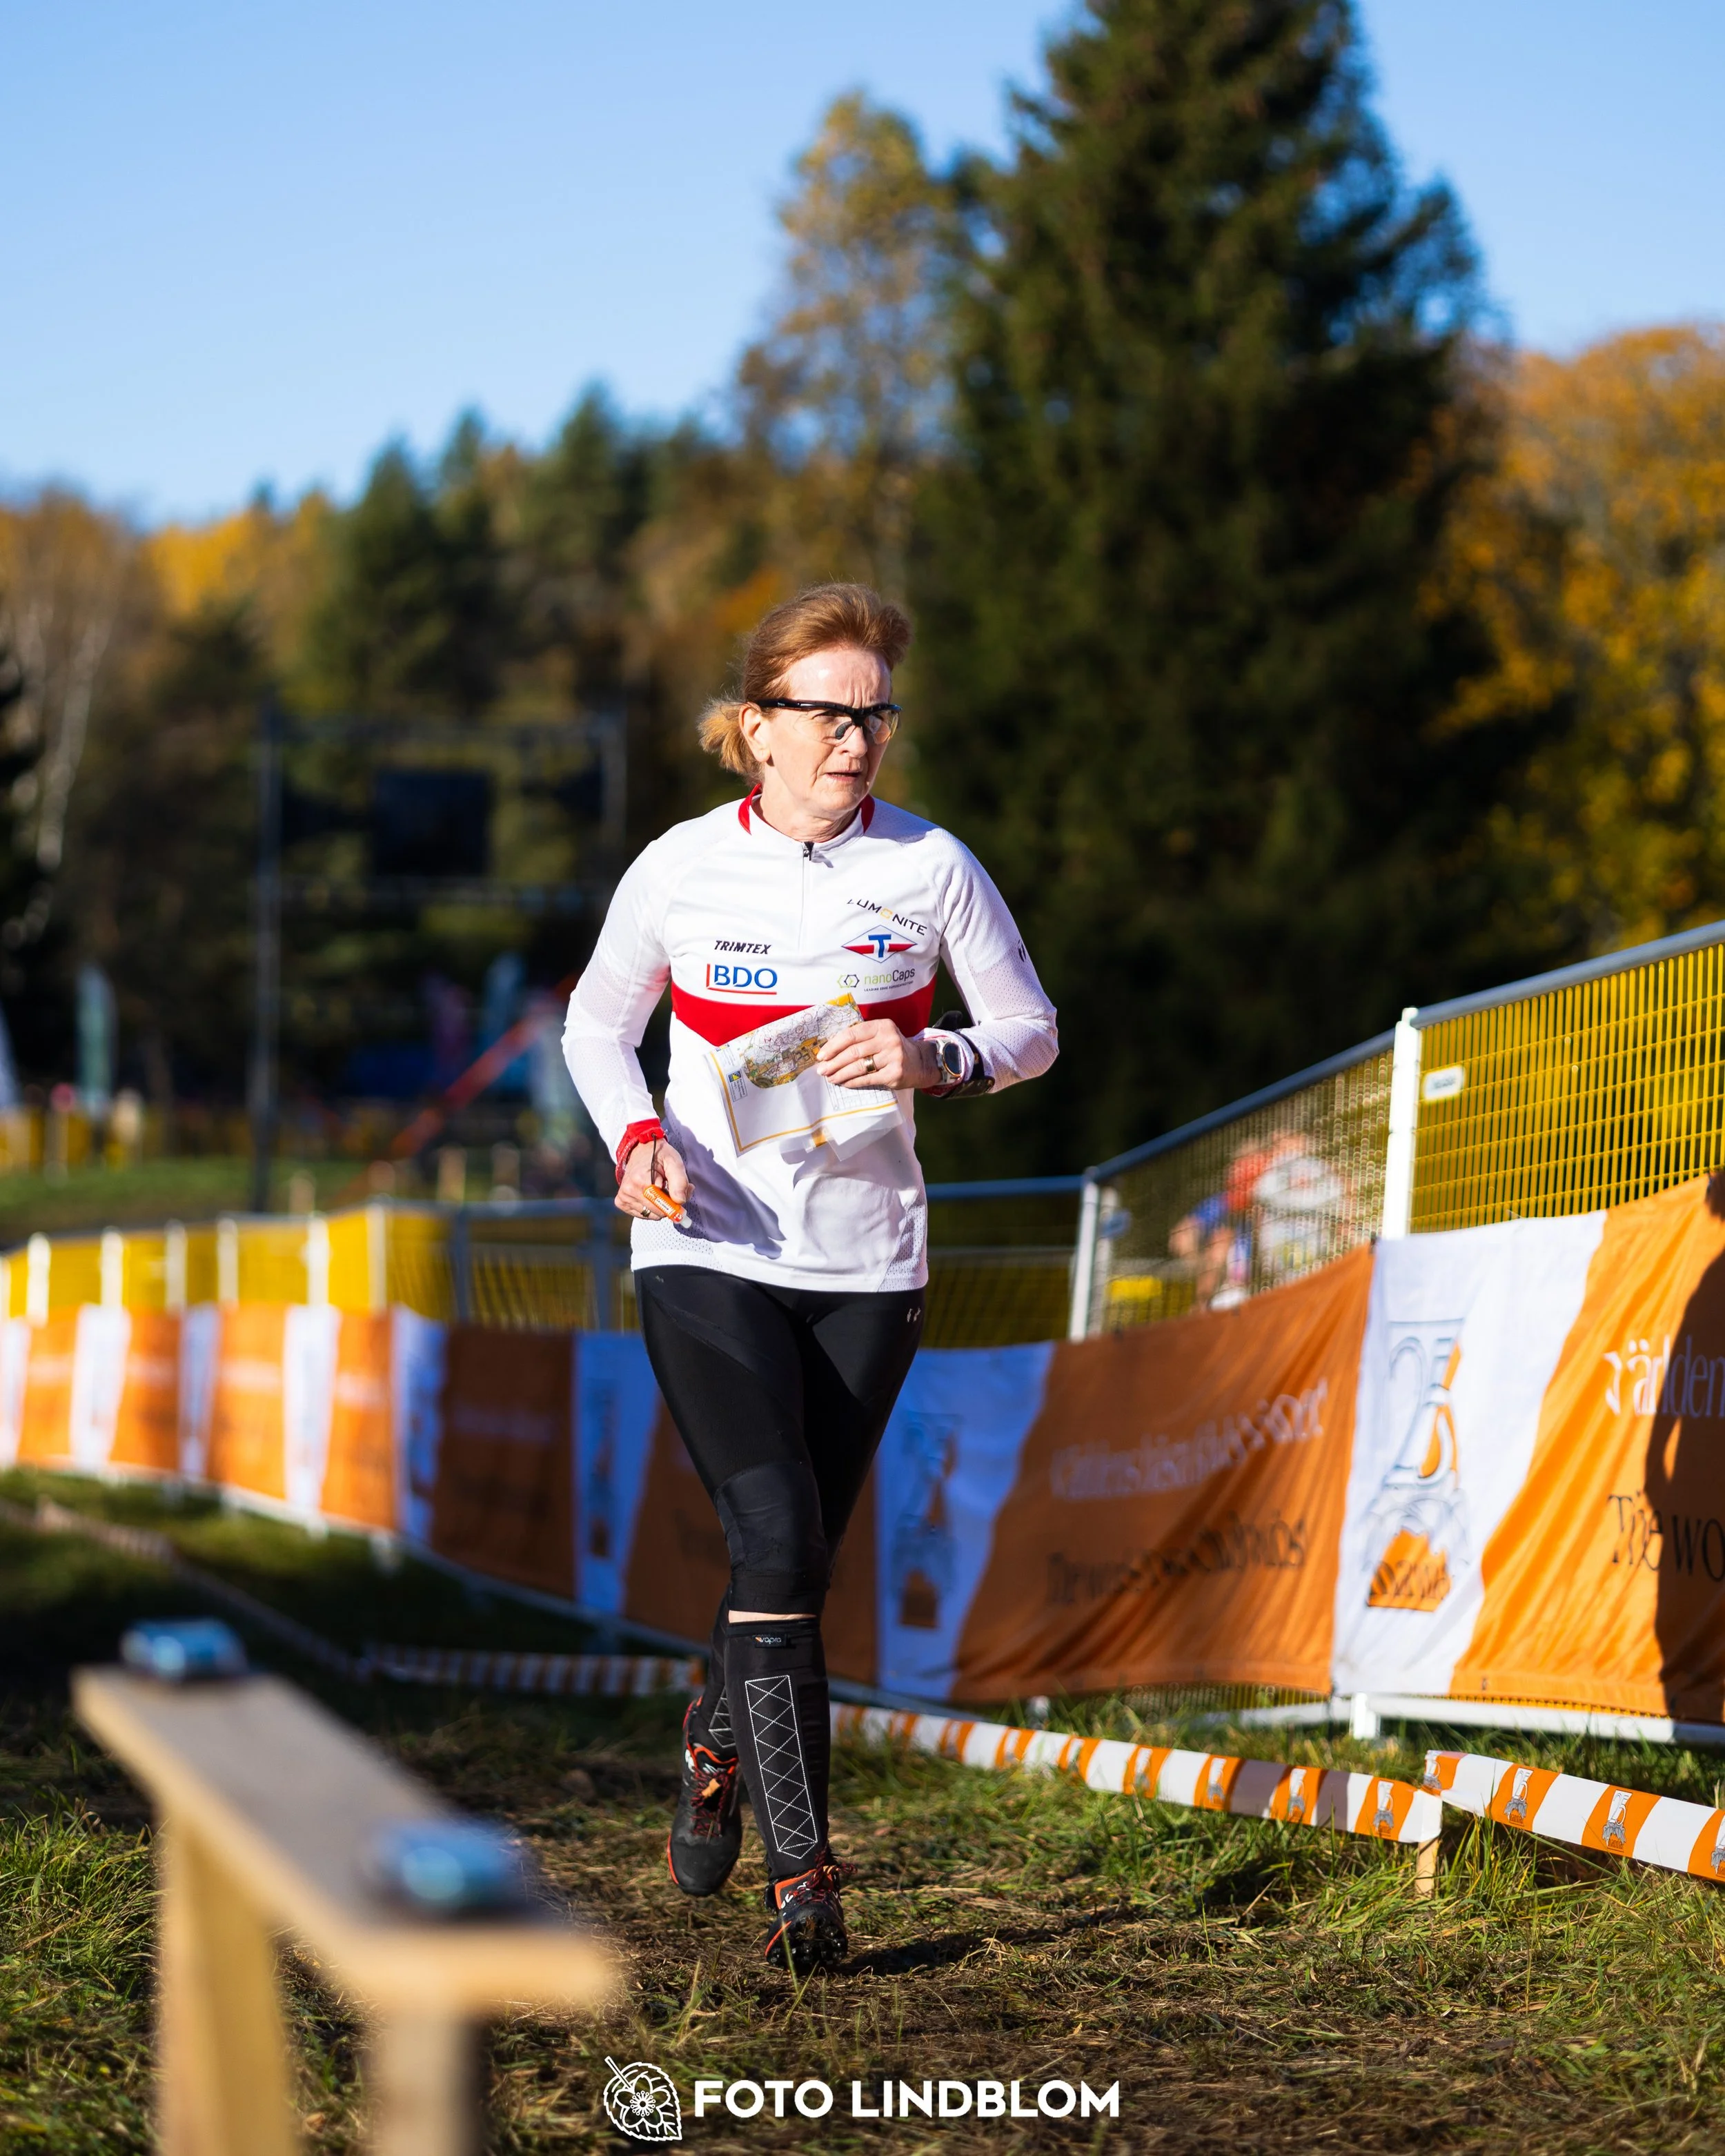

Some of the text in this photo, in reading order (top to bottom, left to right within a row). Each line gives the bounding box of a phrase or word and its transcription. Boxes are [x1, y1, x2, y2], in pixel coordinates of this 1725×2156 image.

[714, 940, 771, 954] TRIMTEX
[714, 965, 778, 989] BDO
[864, 968, 915, 985] nanoCaps
